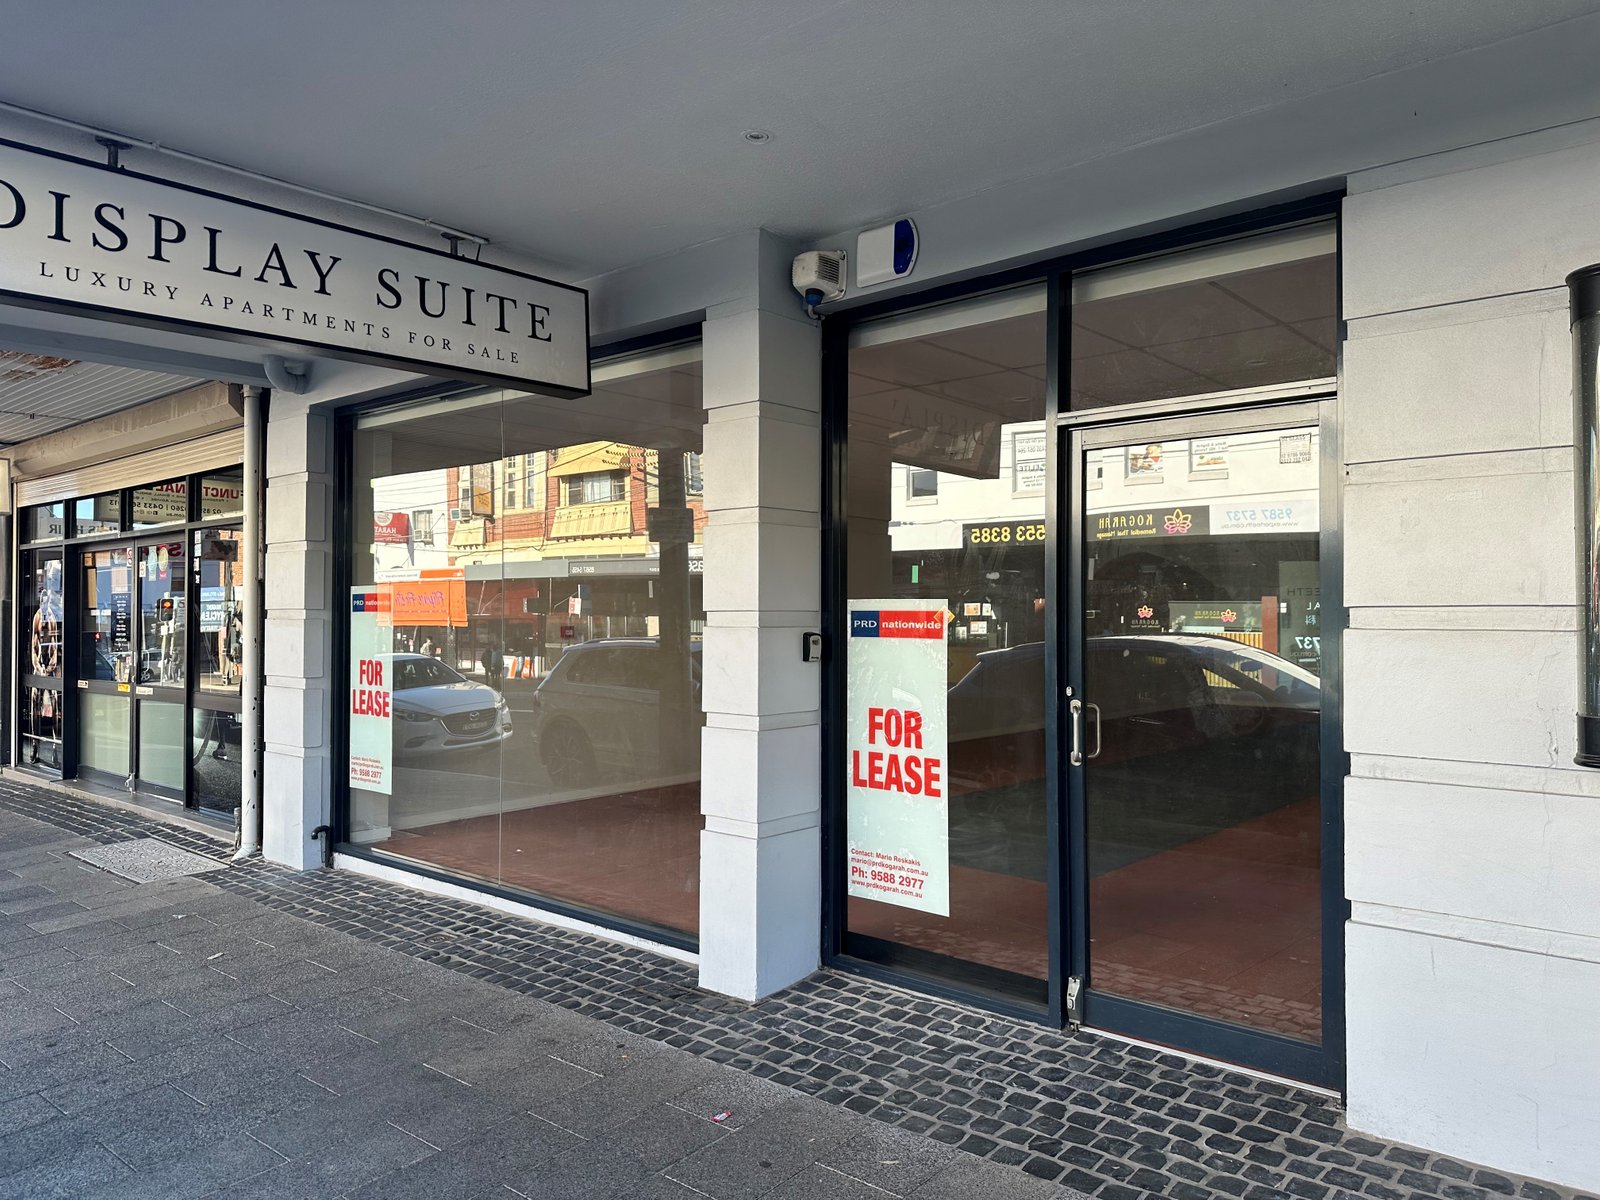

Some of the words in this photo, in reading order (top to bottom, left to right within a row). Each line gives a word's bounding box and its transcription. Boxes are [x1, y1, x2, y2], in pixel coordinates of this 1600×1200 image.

[40, 261, 178, 300] LUXURY
[201, 293, 390, 338] APARTMENTS
[408, 331, 452, 351] FOR
[467, 343, 519, 364] SALE
[376, 268, 552, 342] SUITE
[854, 620, 878, 629] PRD
[882, 619, 942, 631] nationwide
[359, 659, 383, 686] FOR
[352, 688, 390, 718] LEASE
[868, 707, 924, 749] FOR
[852, 749, 942, 798] LEASE
[850, 857, 929, 877] mario@prdkogarah.com.au
[851, 848, 875, 857] Contact:
[875, 852, 893, 861] Mario
[851, 866, 868, 879] Ph:
[870, 869, 896, 884] 9588
[898, 875, 924, 890] 2977
[851, 880, 923, 899] www.prdkogarah.com.au
